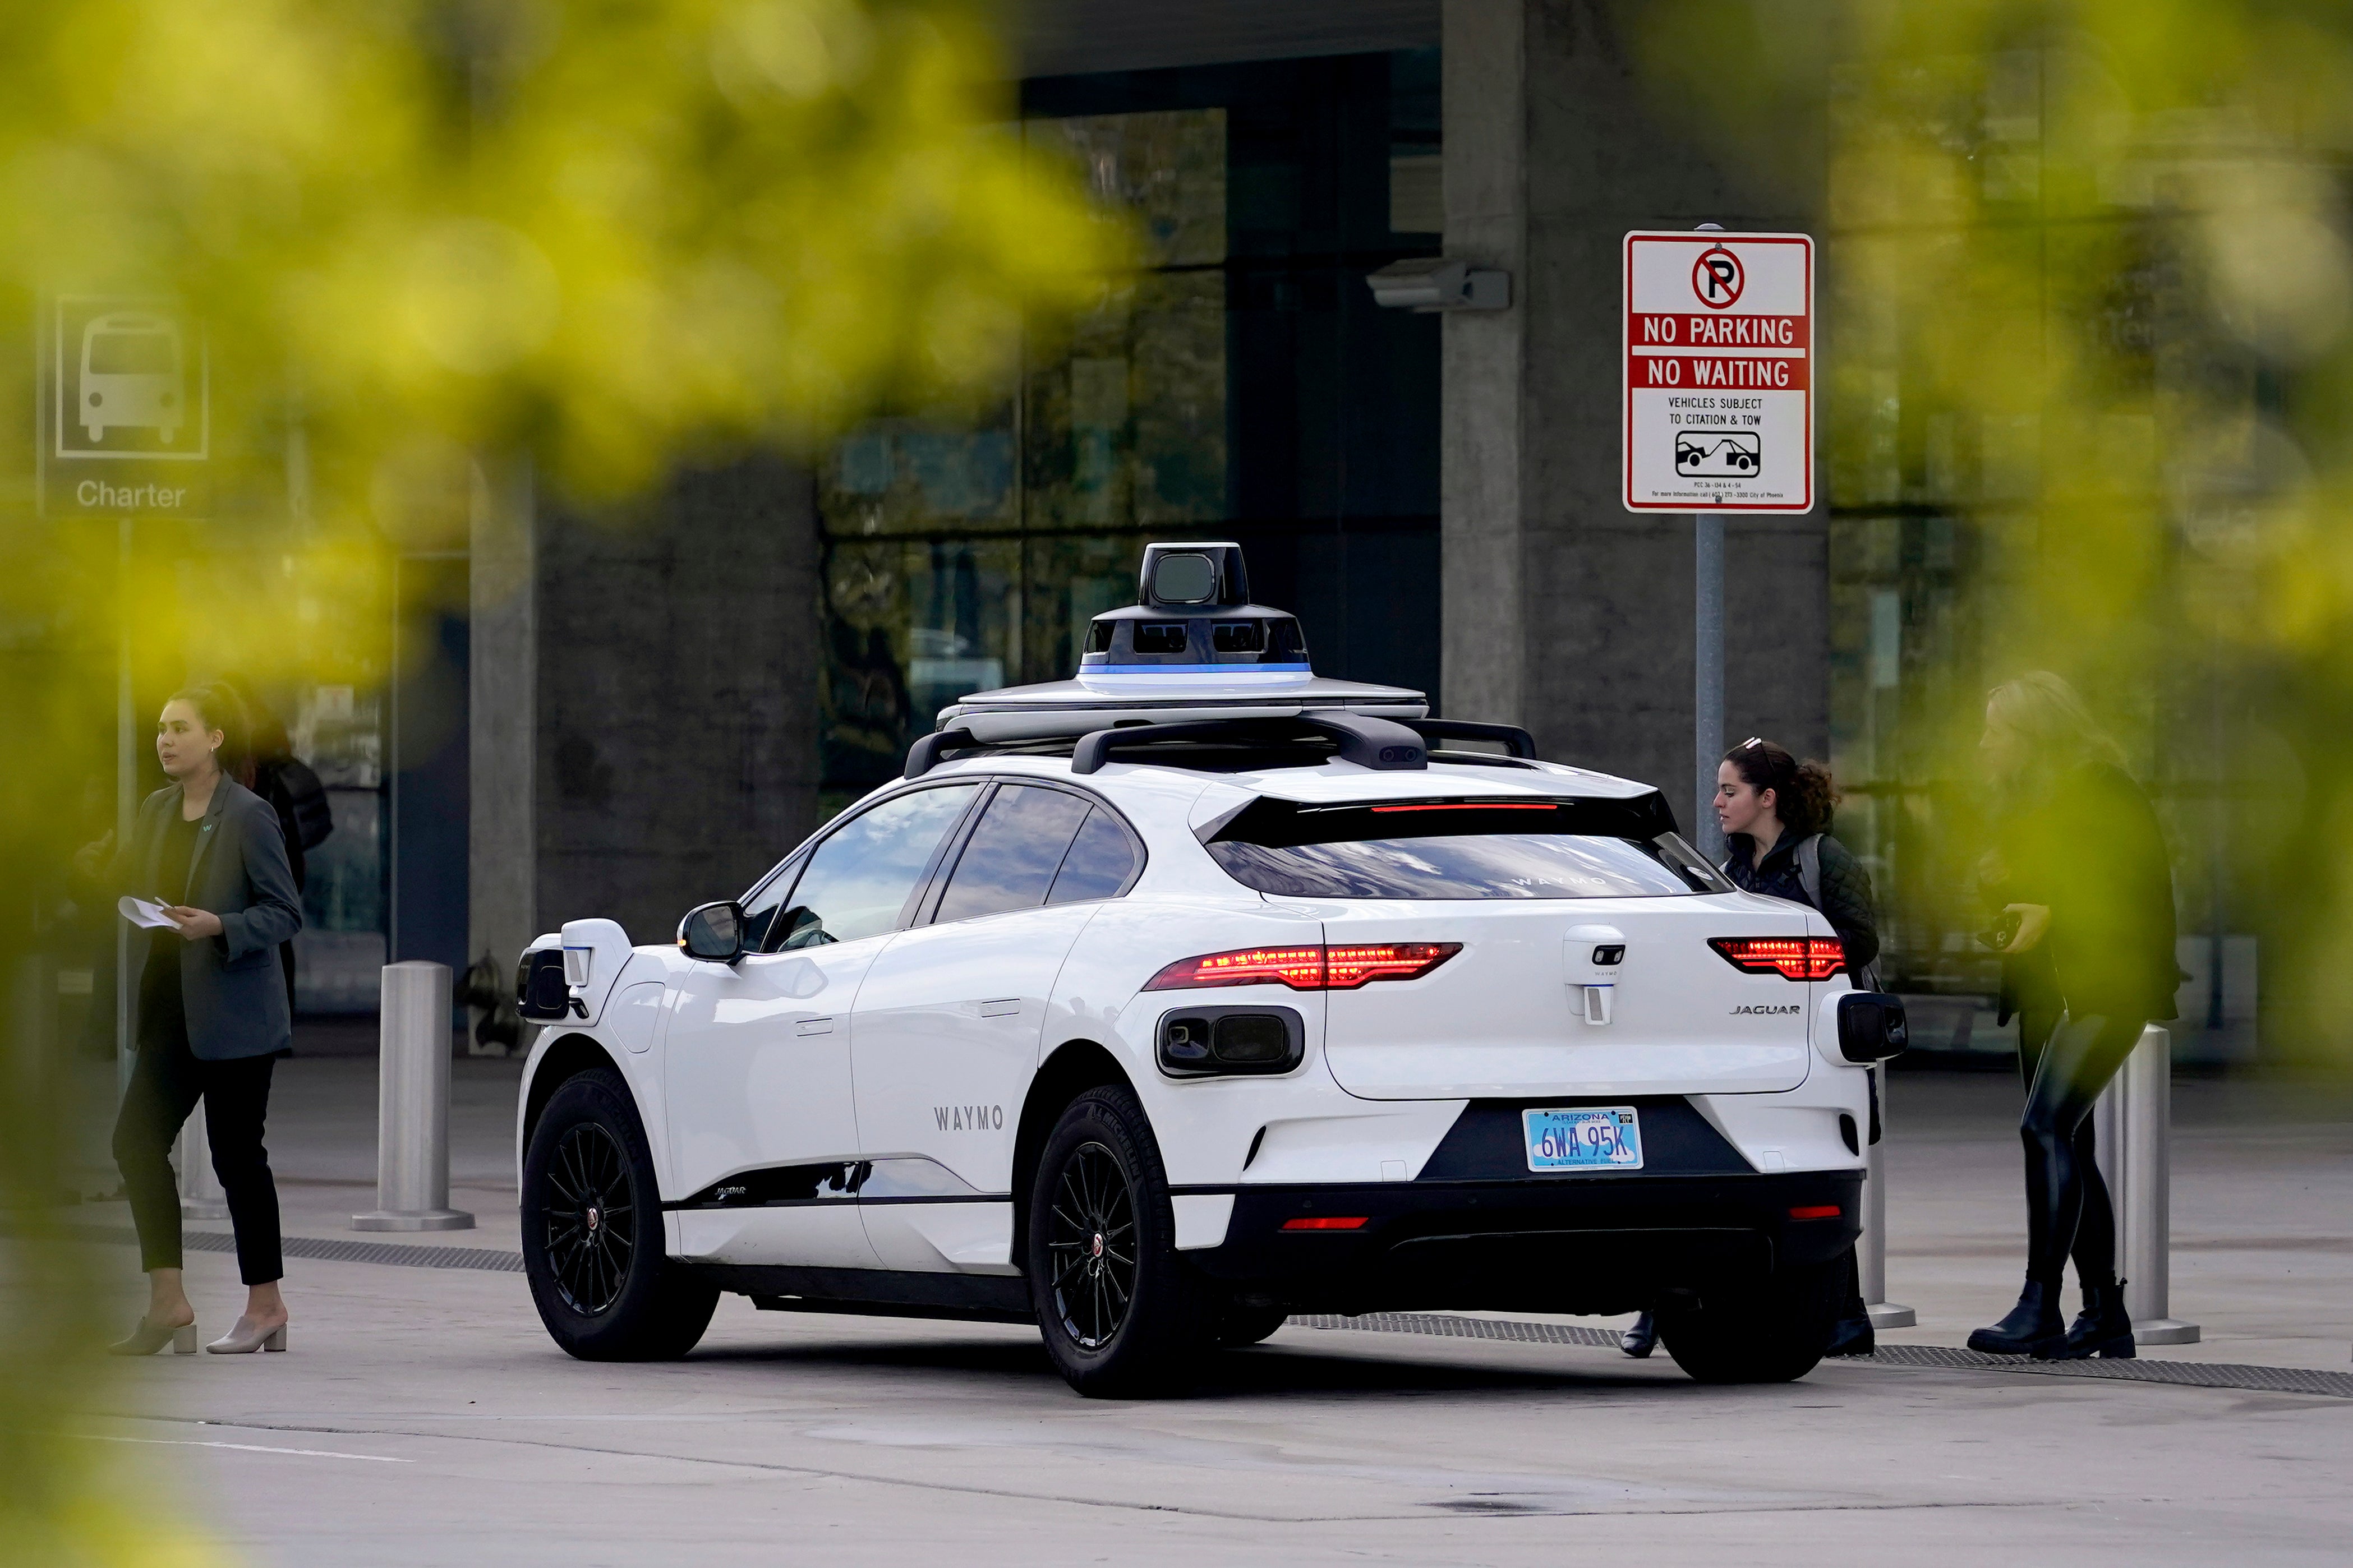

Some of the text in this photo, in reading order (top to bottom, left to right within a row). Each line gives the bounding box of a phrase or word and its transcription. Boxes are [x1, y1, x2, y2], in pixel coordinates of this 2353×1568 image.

[1644, 316, 1793, 345] NO PARKING
[1648, 359, 1789, 387] NO WAITING
[1668, 397, 1762, 409] VEHICLES SUBJECT
[1670, 414, 1761, 426] TO CITATION & TOW
[76, 479, 186, 508] Charter
[1511, 877, 1607, 886] WAYMO
[1729, 1006, 1801, 1015] JAGUAR
[933, 1104, 1003, 1131] WAYMO
[1552, 1113, 1610, 1122] ARIZONA
[1102, 1112, 1141, 1177] MICHELIN
[1542, 1126, 1627, 1157] 6WA 95K
[715, 1186, 747, 1195] JAGUAR
